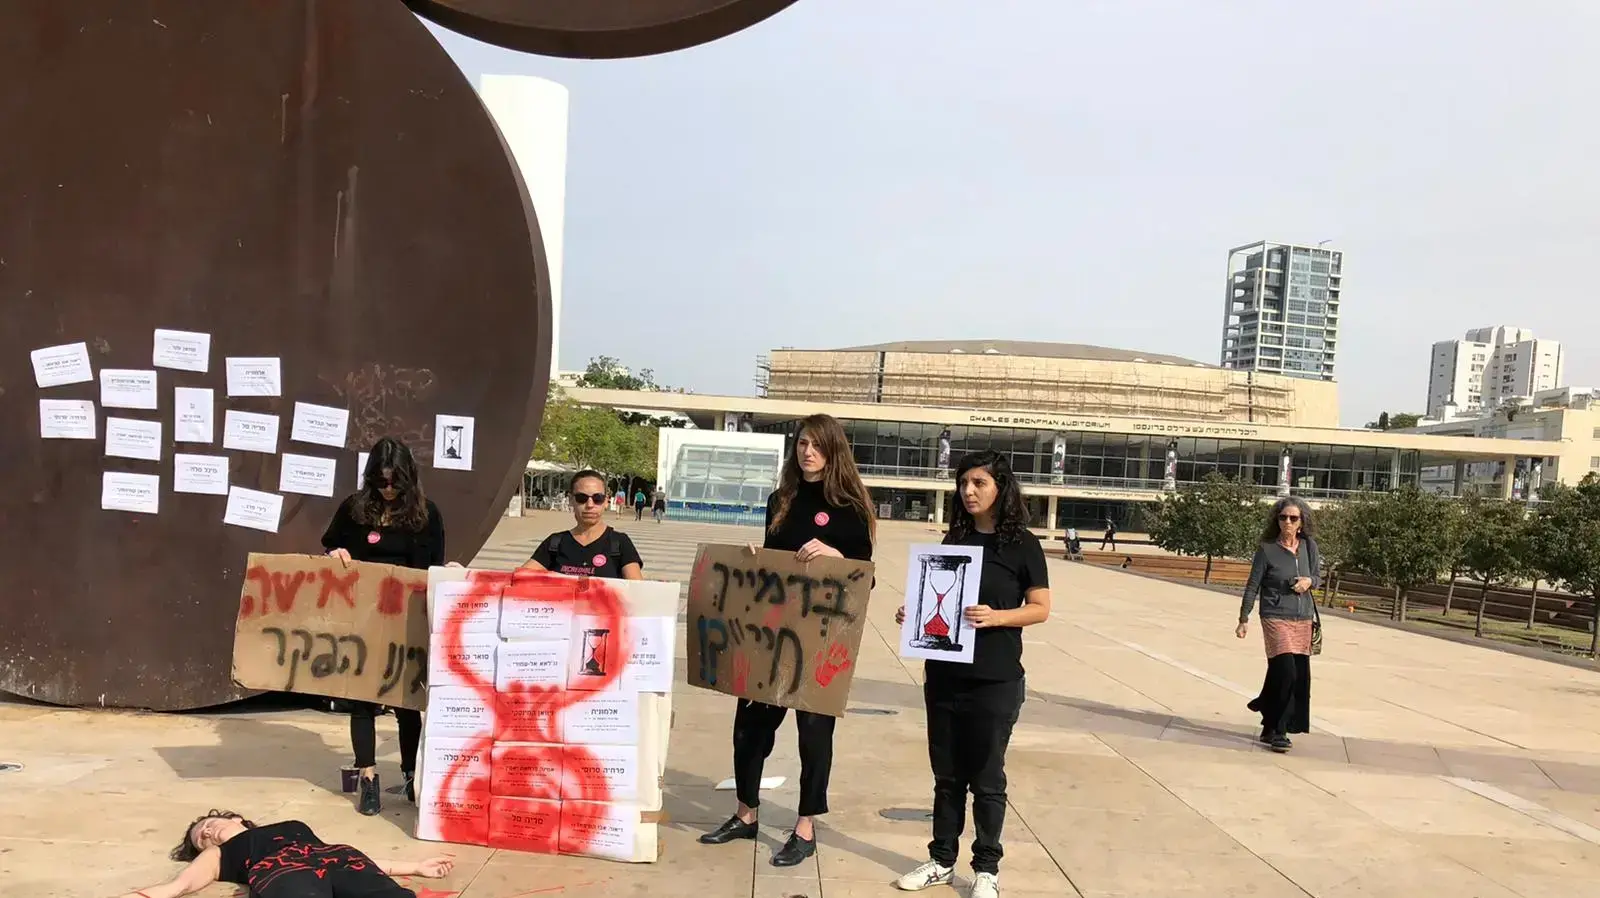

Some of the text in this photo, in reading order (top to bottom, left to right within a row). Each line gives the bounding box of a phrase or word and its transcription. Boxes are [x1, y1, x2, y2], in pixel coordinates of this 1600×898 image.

[969, 415, 1111, 428] CHARLES BRONFMAN AUDITORIUM
[1205, 426, 1237, 435] התרבות
[1238, 428, 1258, 437] היכל
[240, 565, 360, 620] אישה
[541, 606, 555, 614] לילי
[262, 627, 368, 691] הפקר
[443, 753, 479, 762] מיכל סלה
[602, 766, 625, 774] פרחיה
